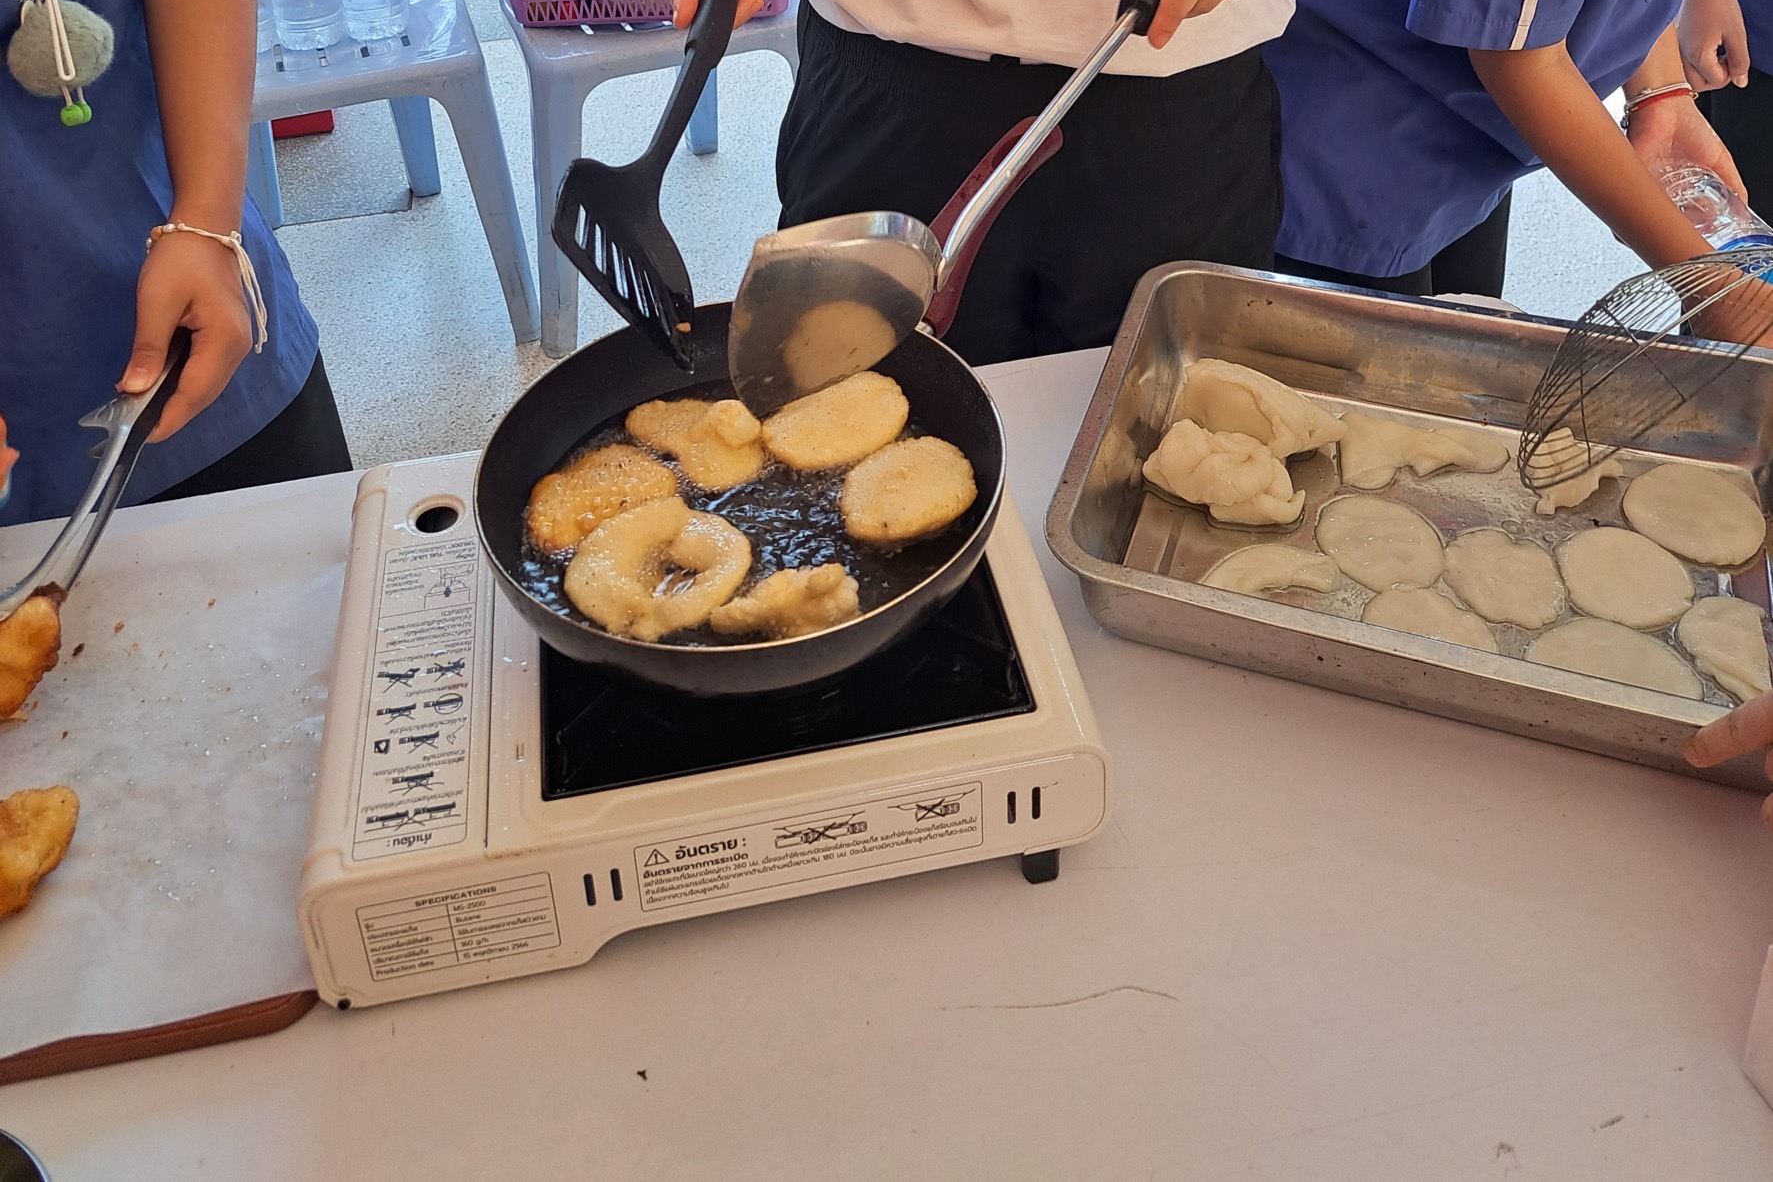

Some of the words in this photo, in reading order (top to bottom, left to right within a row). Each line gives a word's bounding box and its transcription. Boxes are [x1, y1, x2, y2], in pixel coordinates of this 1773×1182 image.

[392, 832, 432, 847] คำเตือน
[674, 836, 739, 861] อันตราย
[643, 852, 749, 879] อันตรายจากการระเบิด
[732, 859, 747, 871] 260
[414, 885, 497, 907] SPECIFICATIONS
